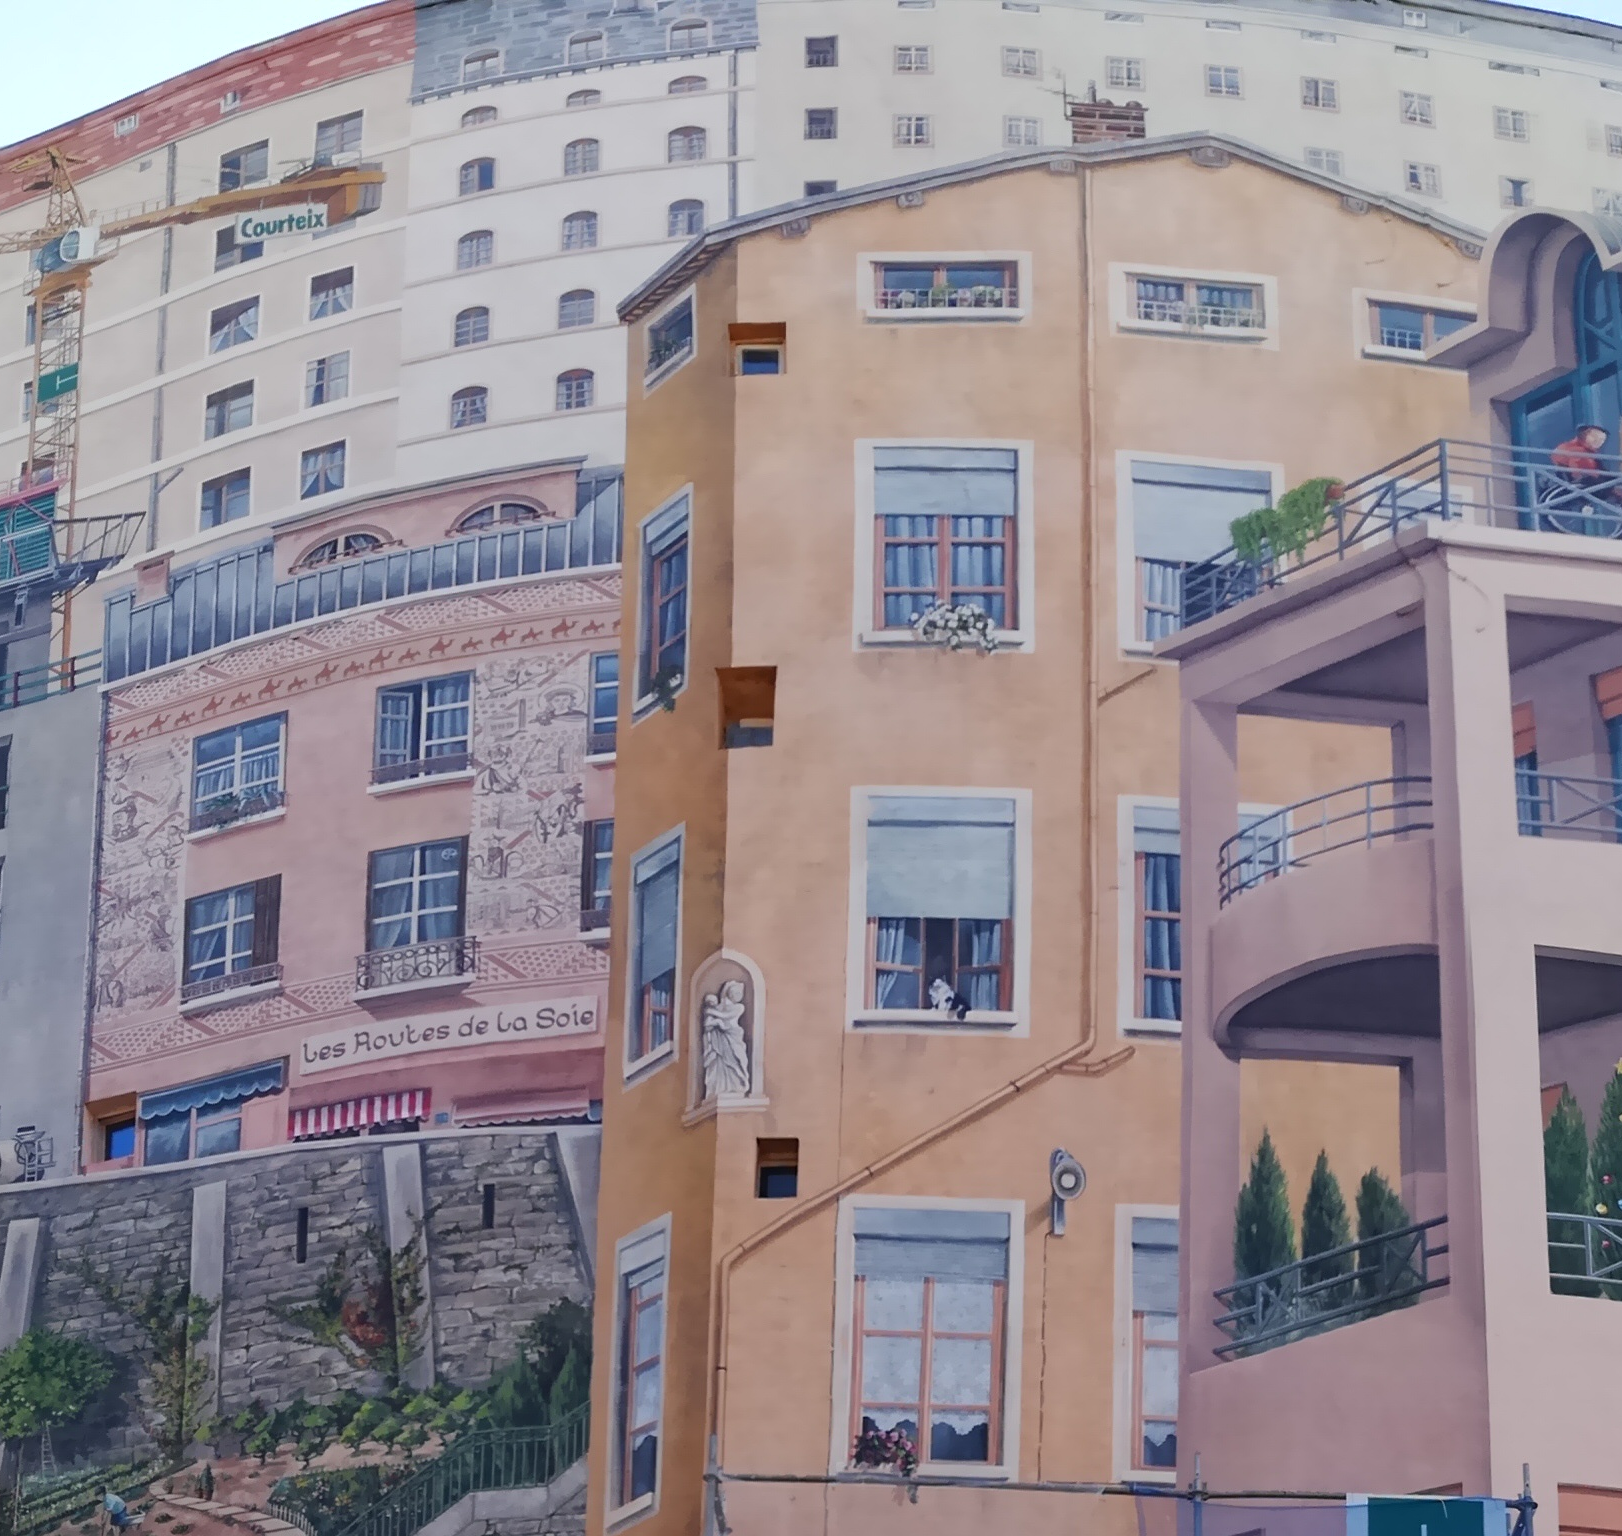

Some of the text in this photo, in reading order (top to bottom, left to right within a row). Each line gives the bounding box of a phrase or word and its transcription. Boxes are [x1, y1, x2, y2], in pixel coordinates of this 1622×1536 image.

[241, 208, 324, 238] Courteix
[303, 1043, 346, 1064] Les
[352, 1023, 450, 1056] Routes
[457, 1015, 489, 1038] de
[535, 1003, 595, 1030] Soie
